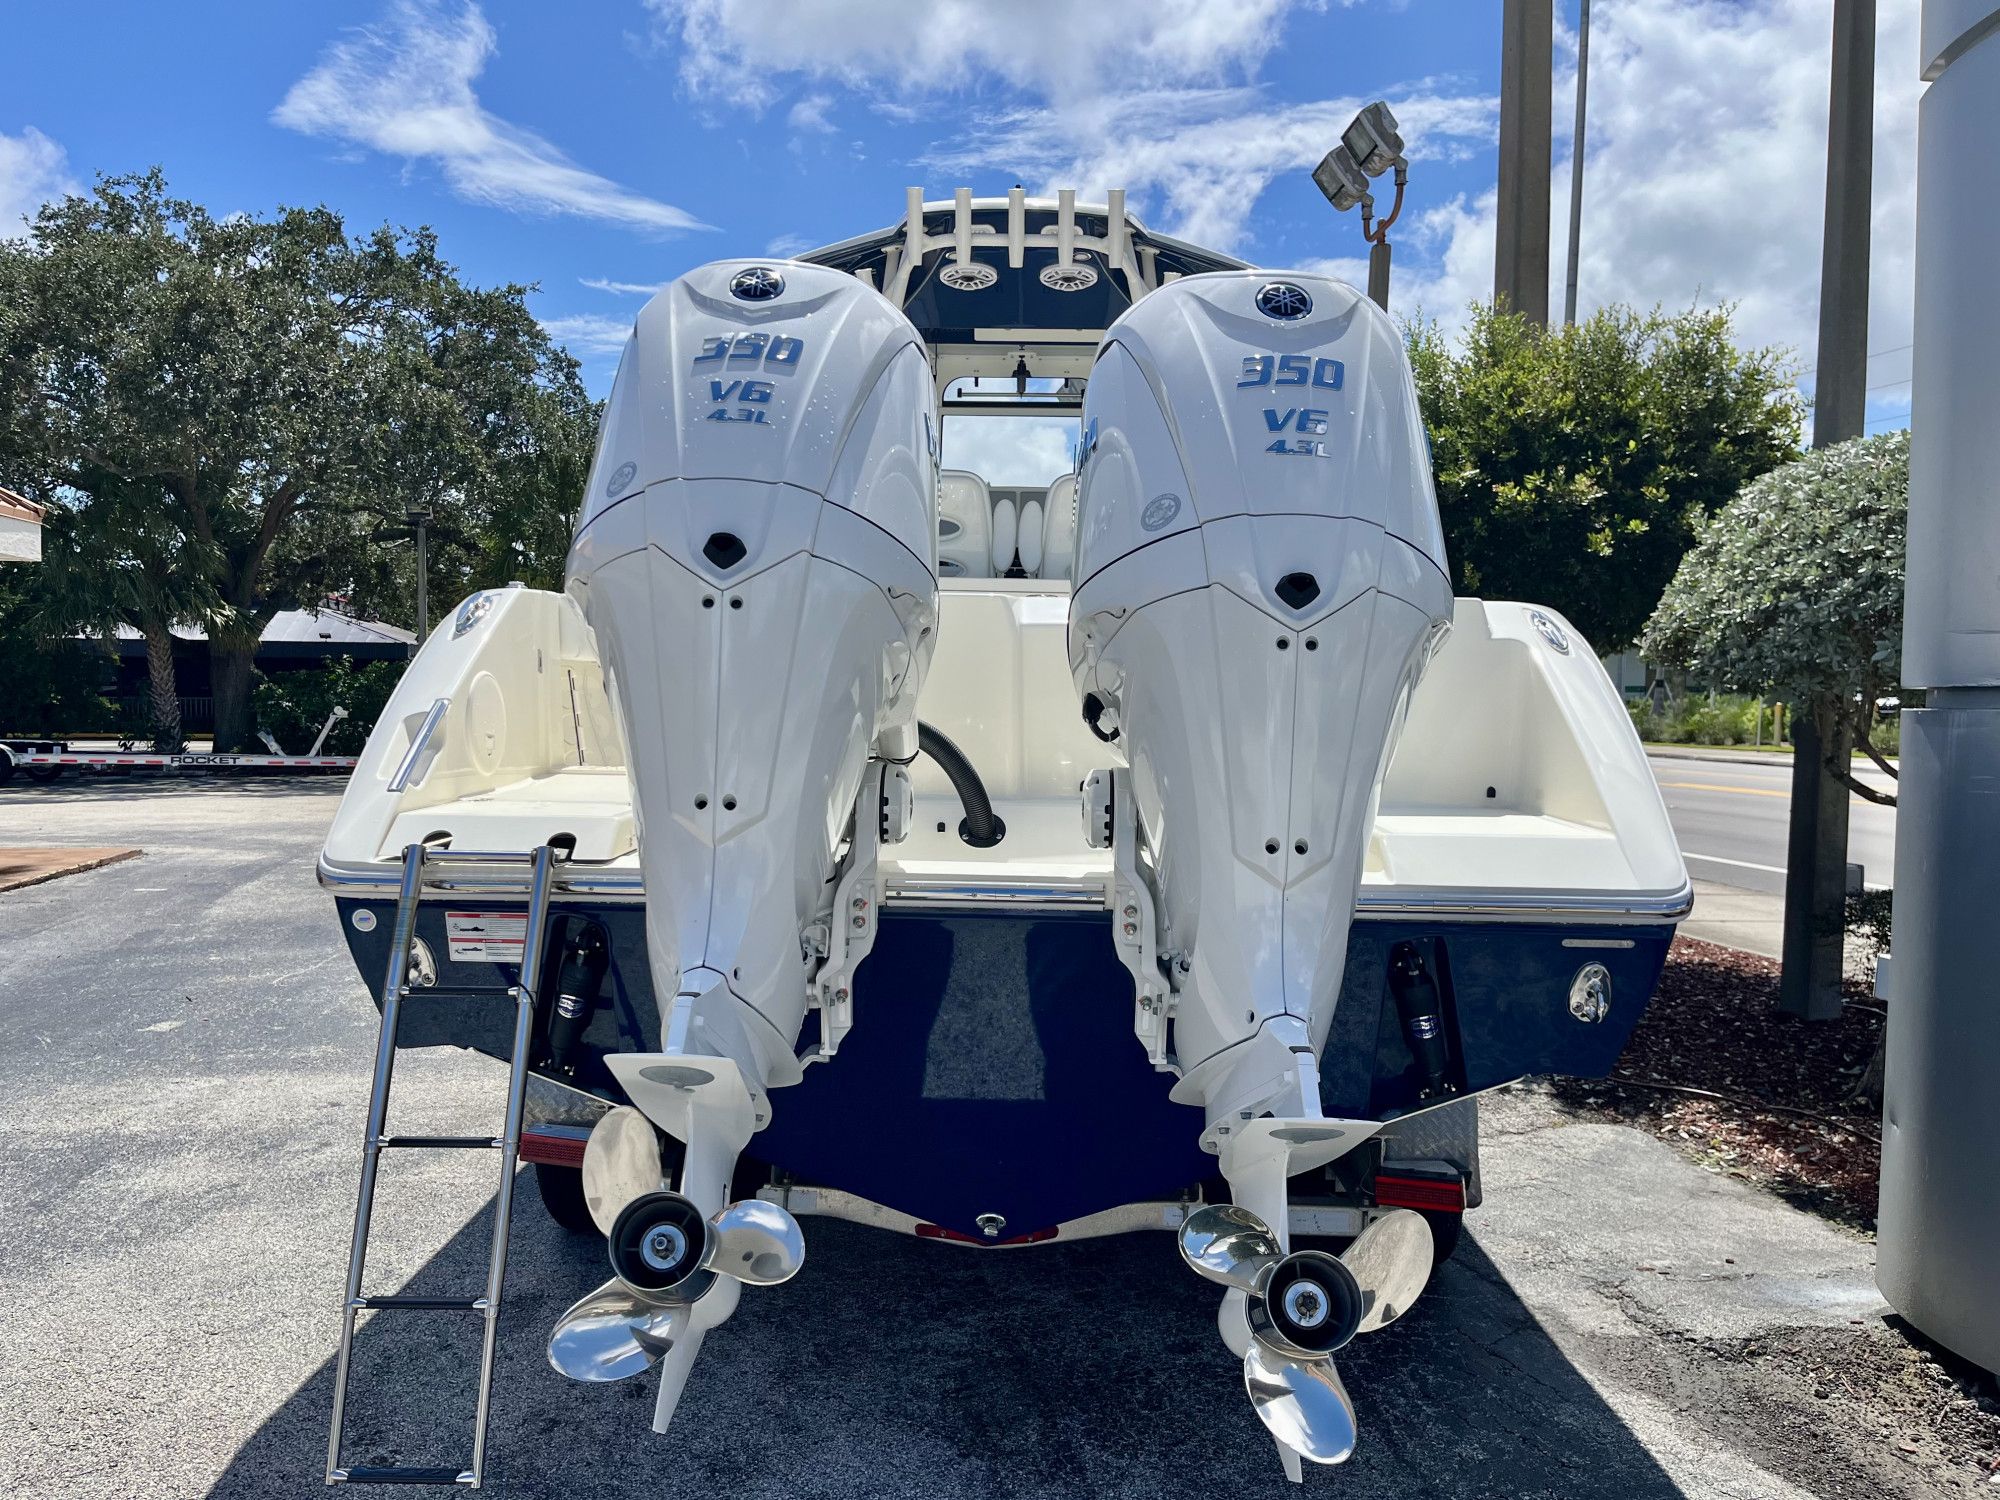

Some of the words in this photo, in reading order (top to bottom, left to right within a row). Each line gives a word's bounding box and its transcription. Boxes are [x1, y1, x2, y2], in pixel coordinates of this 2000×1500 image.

[694, 331, 804, 366] 350
[1237, 354, 1345, 391] 350
[710, 380, 775, 404] V6
[706, 408, 771, 424] 4.3L
[1262, 407, 1329, 435] V6
[1265, 439, 1332, 458] 4.3L
[170, 756, 240, 764] ROCKET
